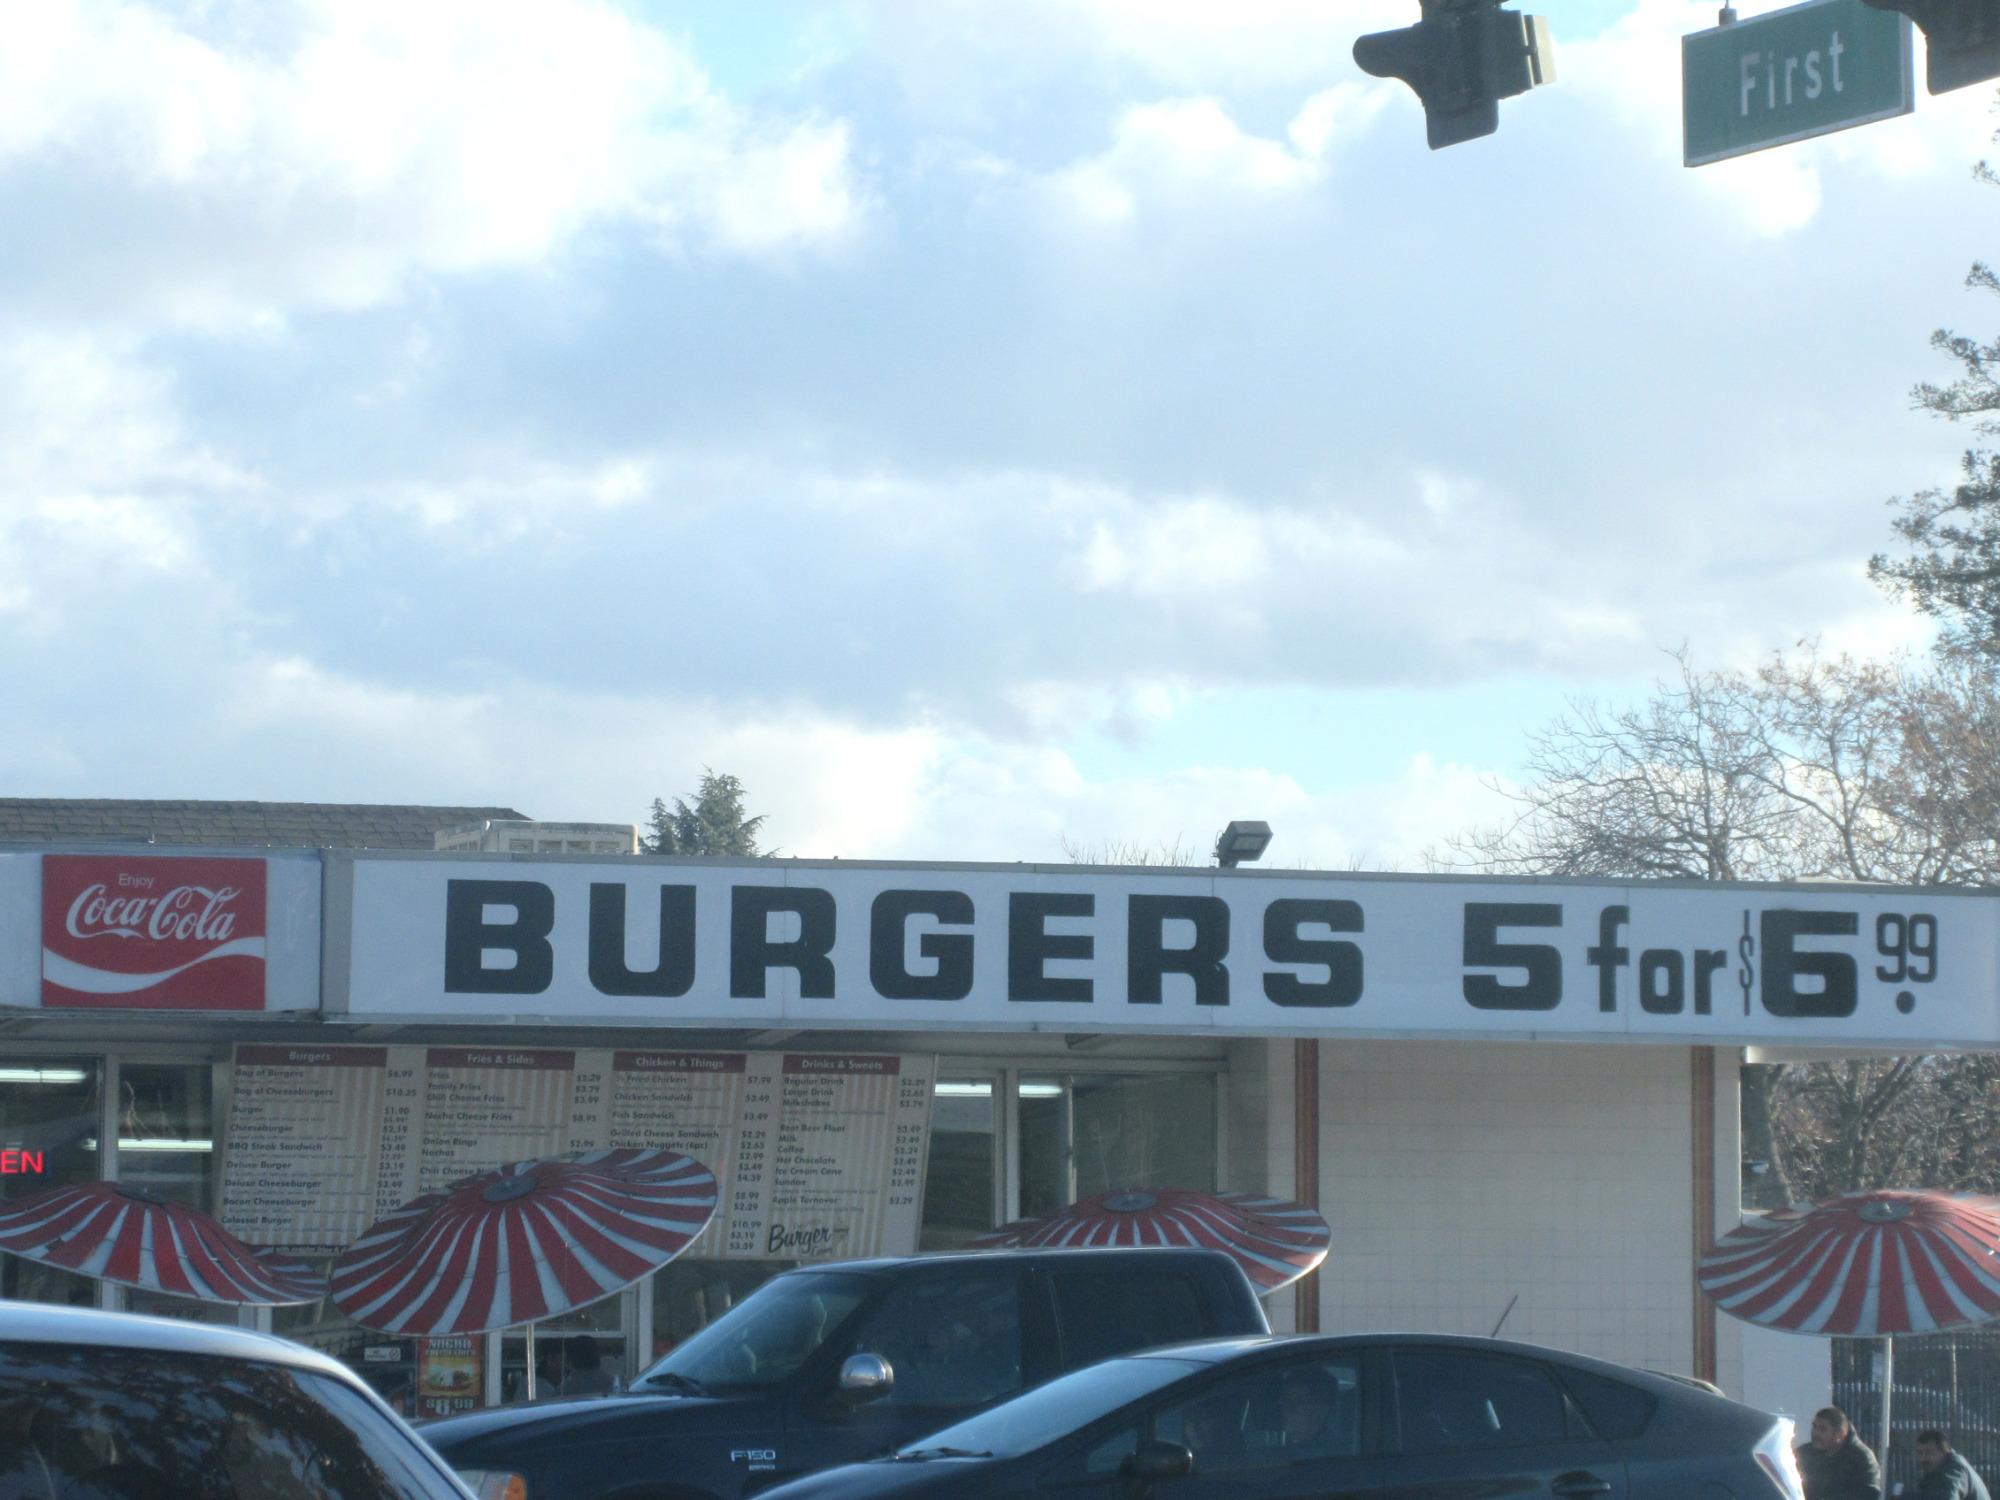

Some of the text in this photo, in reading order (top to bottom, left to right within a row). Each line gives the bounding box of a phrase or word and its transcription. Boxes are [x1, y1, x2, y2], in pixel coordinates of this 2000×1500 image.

[1741, 30, 1844, 117] First
[117, 872, 155, 888] Enjoy
[444, 879, 1365, 1009] BURGERS
[1462, 902, 1564, 1012] 5
[1587, 904, 1727, 1016] for
[289, 1050, 332, 1062] Burgers
[467, 1055, 493, 1065] Fries
[506, 1055, 535, 1065] Sides
[636, 1057, 677, 1068] Chicken
[690, 1057, 724, 1068] Things
[802, 1060, 834, 1071] Drinks
[848, 1060, 882, 1071] Sweets
[266, 1070, 304, 1079] Burgers
[428, 1072, 450, 1080] Fries
[626, 1074, 650, 1083] Fried
[653, 1074, 687, 1083] Chicken
[784, 1077, 818, 1087] Regular
[820, 1077, 845, 1087] Drink
[460, 1083, 481, 1092] Fries
[266, 1088, 334, 1098] Cheeseburgers
[484, 1093, 505, 1103] Fries
[614, 1093, 649, 1102] Chicken
[651, 1093, 693, 1102] Sandwich
[783, 1089, 811, 1098] Large
[812, 1089, 834, 1098] Drink
[782, 1099, 830, 1107] Milkshakes
[232, 1106, 263, 1115] Burger
[633, 1111, 674, 1120] Sandwich
[456, 1112, 488, 1122] Cheese
[491, 1112, 513, 1122] Fries
[230, 1124, 294, 1134] Cheeseburger
[644, 1129, 675, 1139] Cheese
[678, 1129, 719, 1139] Sandwich
[423, 1138, 450, 1147] Onion
[778, 1135, 797, 1143] Milk
[228, 1142, 249, 1151] BBQ
[252, 1142, 276, 1151] Steak
[279, 1142, 323, 1151] Sandwich
[609, 1140, 643, 1150] Chicken
[646, 1140, 684, 1150] Nuggets
[777, 1145, 804, 1154] Coffee
[226, 1160, 257, 1170] Deluxe
[260, 1160, 292, 1170] Burger
[776, 1156, 793, 1165] Hot
[794, 1156, 836, 1165] Chocolate
[442, 1167, 474, 1176] Cheese
[775, 1167, 787, 1177] Ice
[790, 1167, 818, 1177] Cream
[820, 1167, 843, 1177] Cone
[224, 1179, 256, 1189] Deluxe
[259, 1179, 322, 1189] Cheeseburger
[774, 1178, 806, 1187] Sundae
[223, 1198, 251, 1208] Bacon
[254, 1198, 317, 1208] Cheeseburger
[772, 1196, 797, 1206] Apple
[800, 1196, 838, 1206] Turnover
[261, 1216, 292, 1226] Burger
[767, 1223, 832, 1254] Burger
